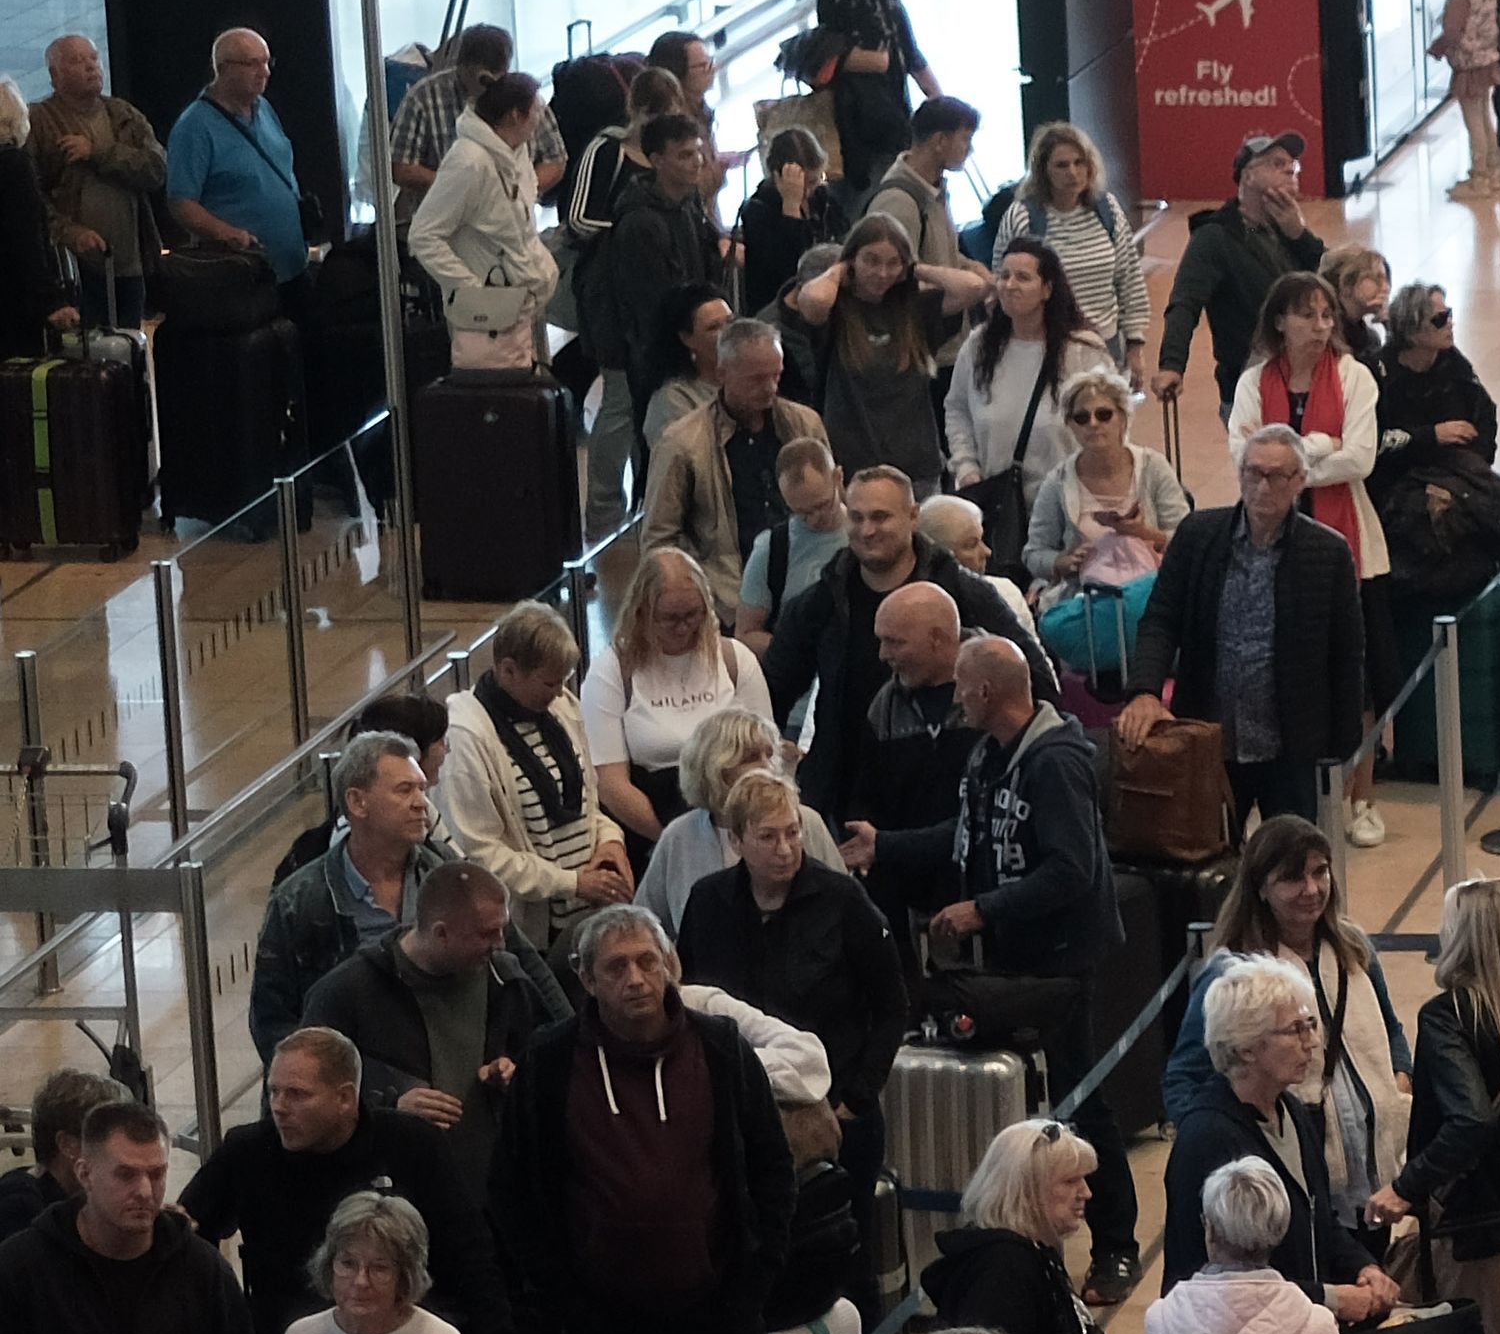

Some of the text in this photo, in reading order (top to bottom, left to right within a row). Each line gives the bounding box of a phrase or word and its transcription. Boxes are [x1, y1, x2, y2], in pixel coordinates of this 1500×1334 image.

[1196, 60, 1233, 90] Fly
[1154, 85, 1278, 107] refreshed!
[651, 692, 714, 709] MILANO
